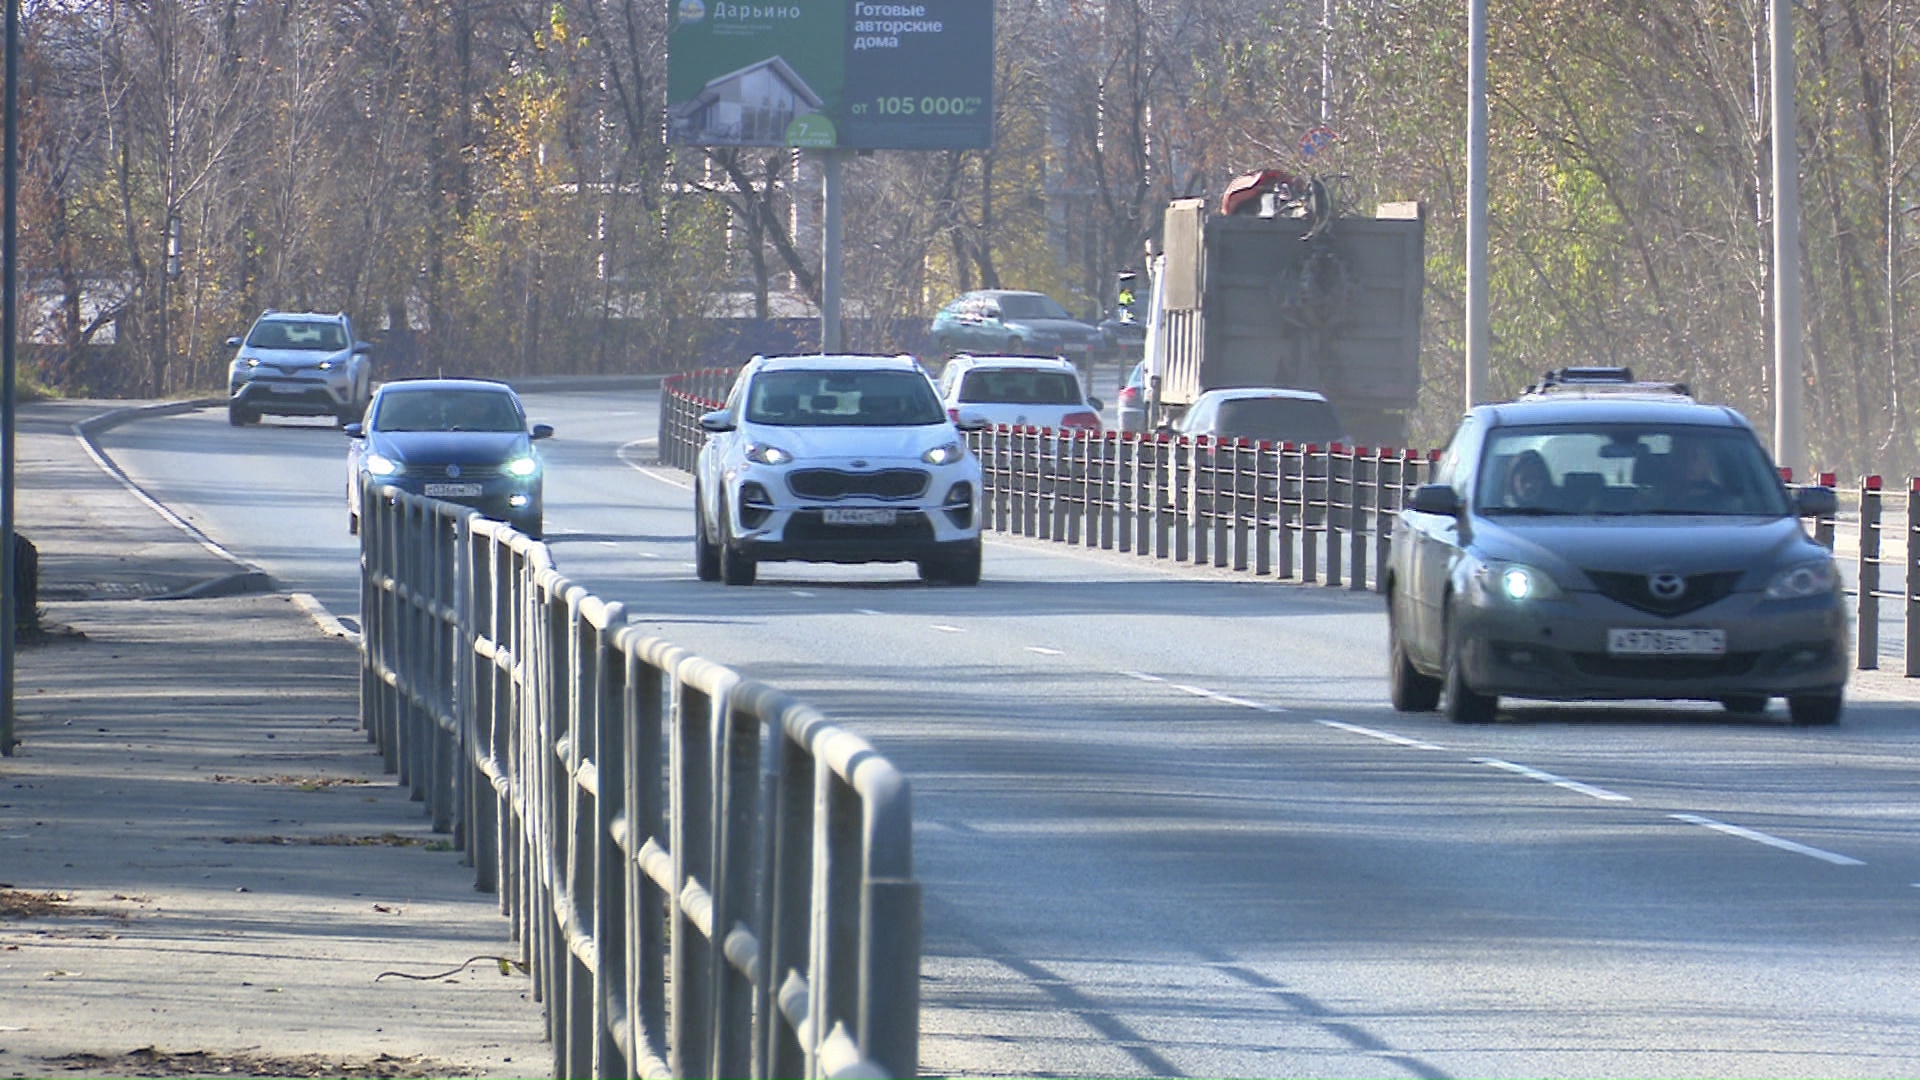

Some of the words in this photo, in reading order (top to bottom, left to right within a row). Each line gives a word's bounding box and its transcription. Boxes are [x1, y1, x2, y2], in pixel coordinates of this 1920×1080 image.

[713, 2, 801, 24] Дарьино
[855, 1, 926, 17] Готовые
[855, 16, 943, 35] авторские
[854, 36, 899, 50] дома
[876, 96, 915, 115] 105
[920, 96, 965, 115] 000
[799, 123, 809, 137] 7
